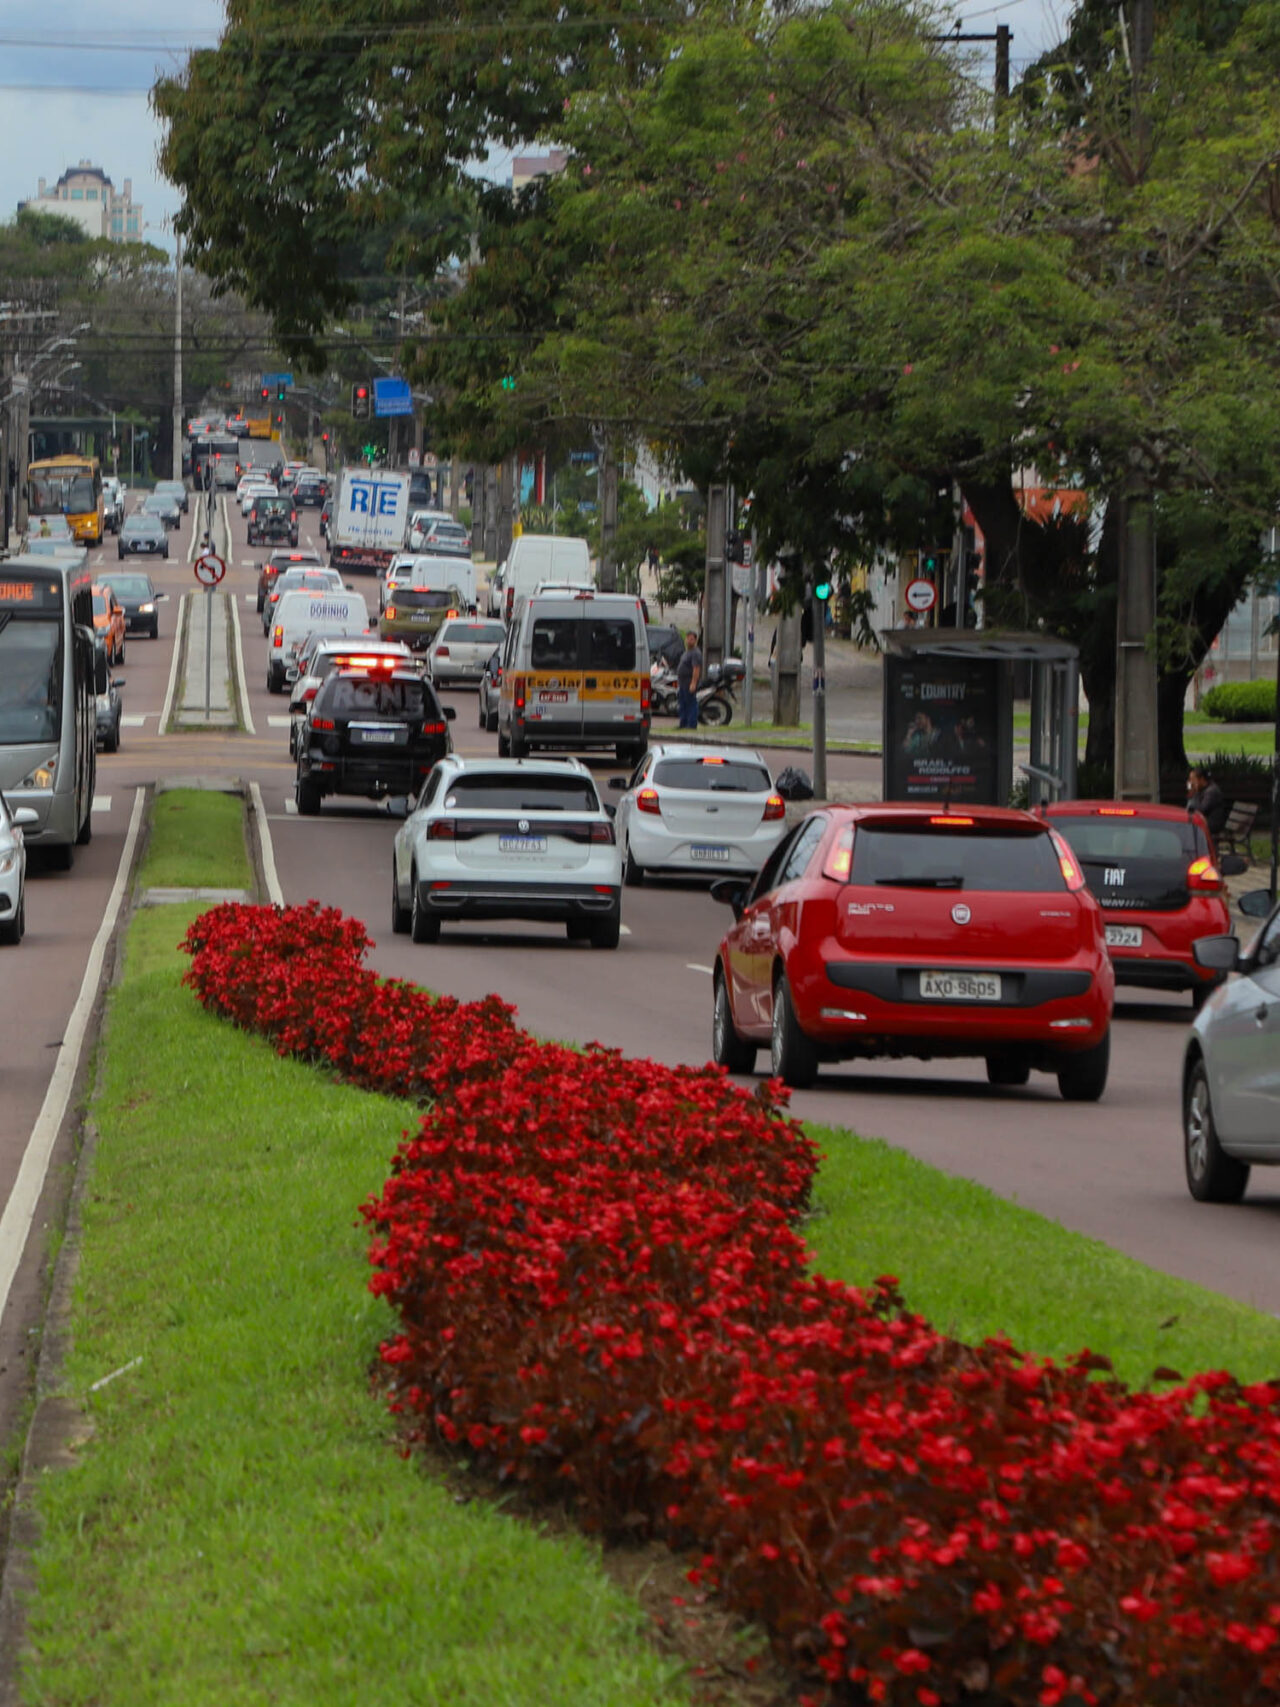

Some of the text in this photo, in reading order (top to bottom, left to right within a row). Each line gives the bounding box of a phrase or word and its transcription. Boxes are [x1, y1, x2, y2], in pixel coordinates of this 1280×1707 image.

[350, 478, 402, 518] RTE
[310, 602, 349, 618] DORINHO
[613, 677, 639, 689] 673
[920, 682, 967, 700] COUNTRY
[1104, 868, 1126, 887] FIAT
